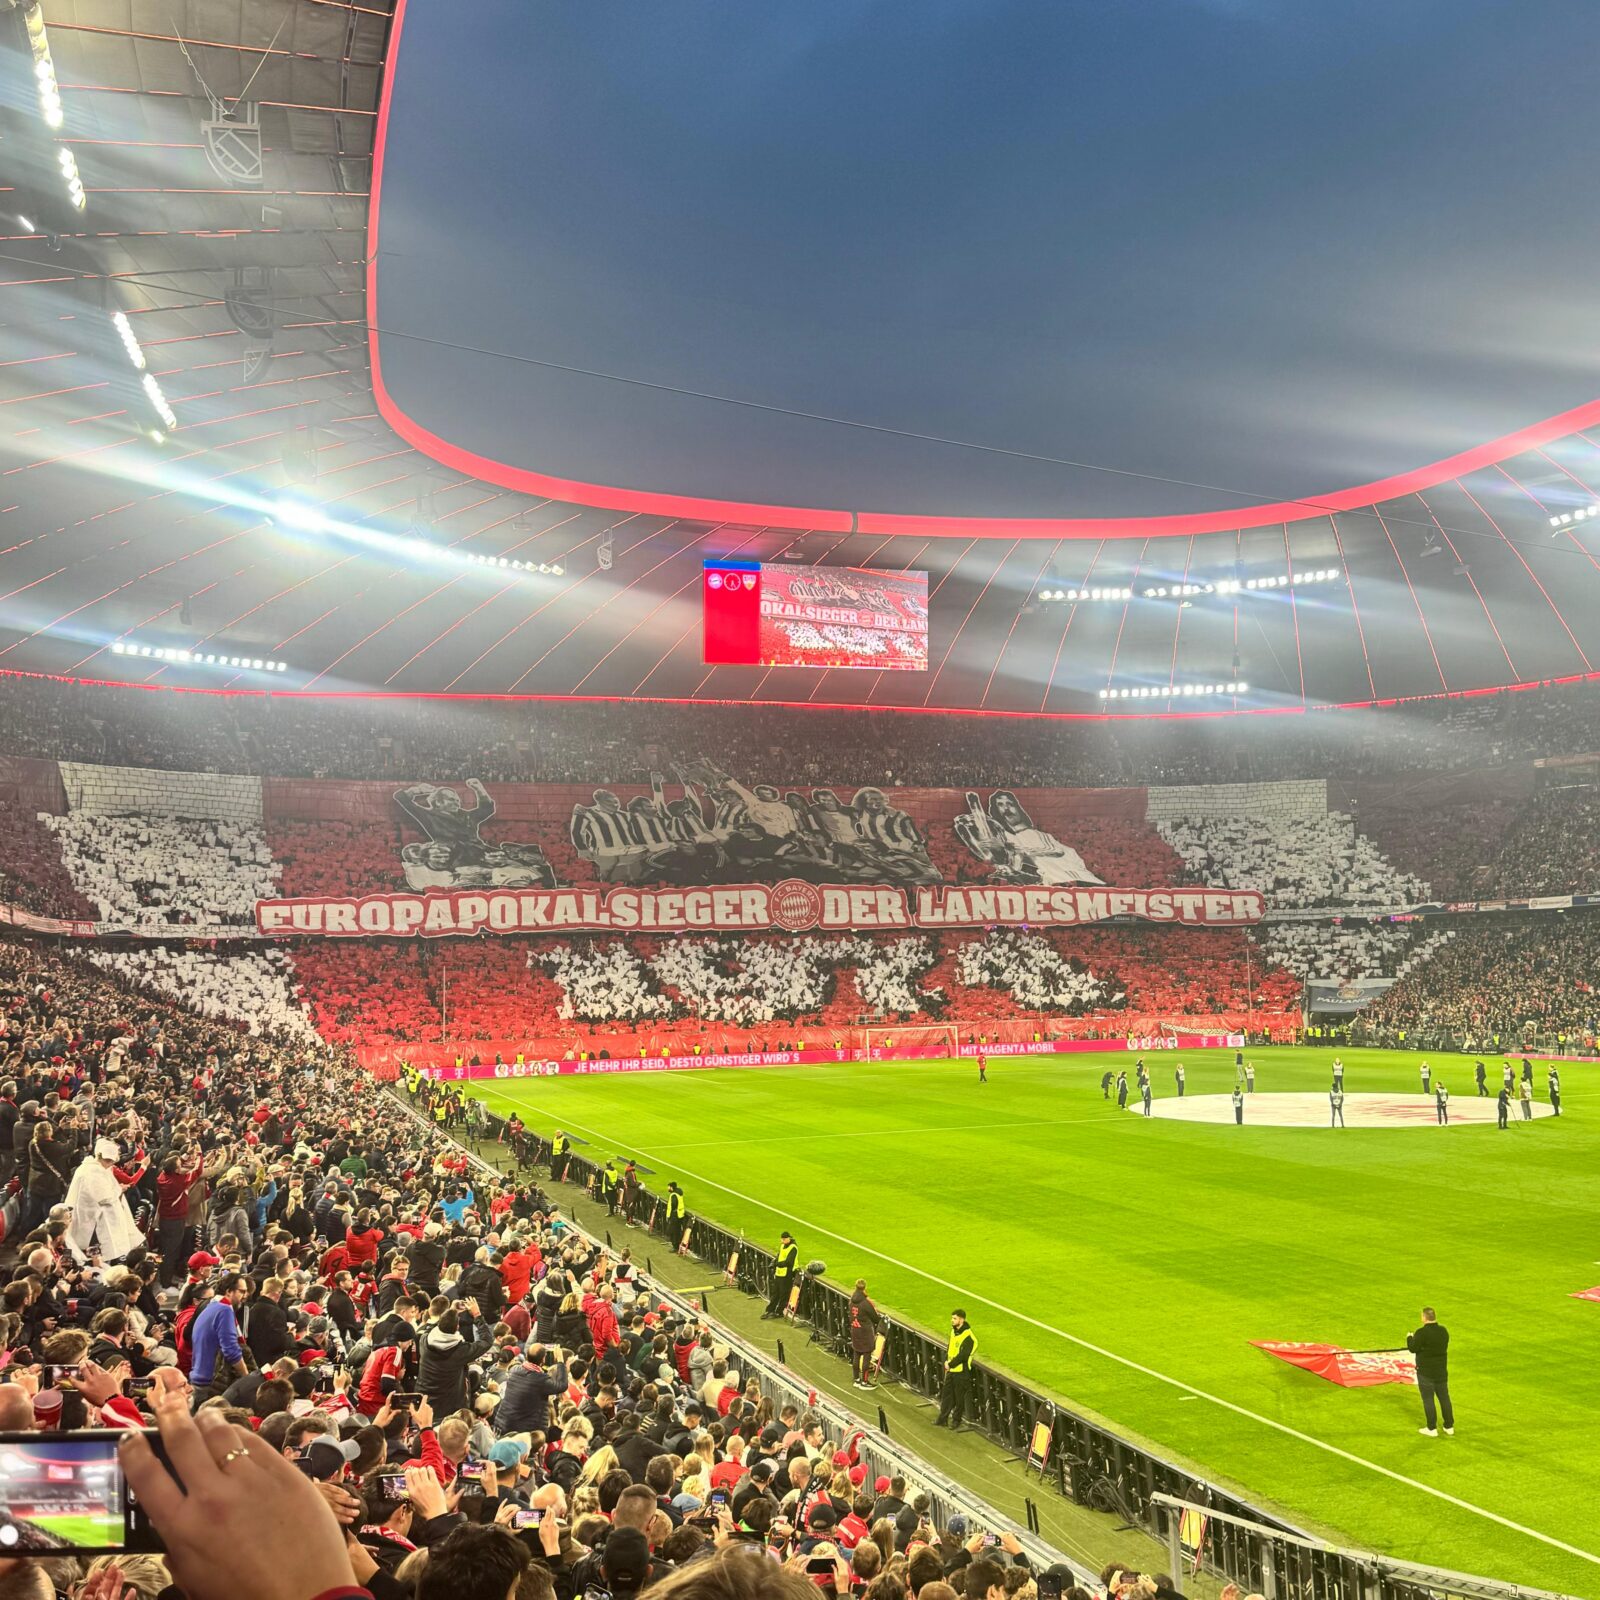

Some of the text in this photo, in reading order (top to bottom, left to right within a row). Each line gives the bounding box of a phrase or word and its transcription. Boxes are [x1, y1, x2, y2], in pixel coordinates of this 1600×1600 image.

[874, 615, 899, 628] DER
[260, 889, 1263, 932] EUROPAPOKALSIEGER DER LANDESMEISTER
[961, 1043, 1056, 1055] MIT MAGENTA MOBIL
[574, 1062, 588, 1073] JE
[589, 1061, 620, 1072] MEHR
[622, 1060, 641, 1071] IHR
[642, 1058, 668, 1071] SEID,
[670, 1056, 703, 1068] DESTO
[704, 1053, 761, 1067] GÜNSTIGER
